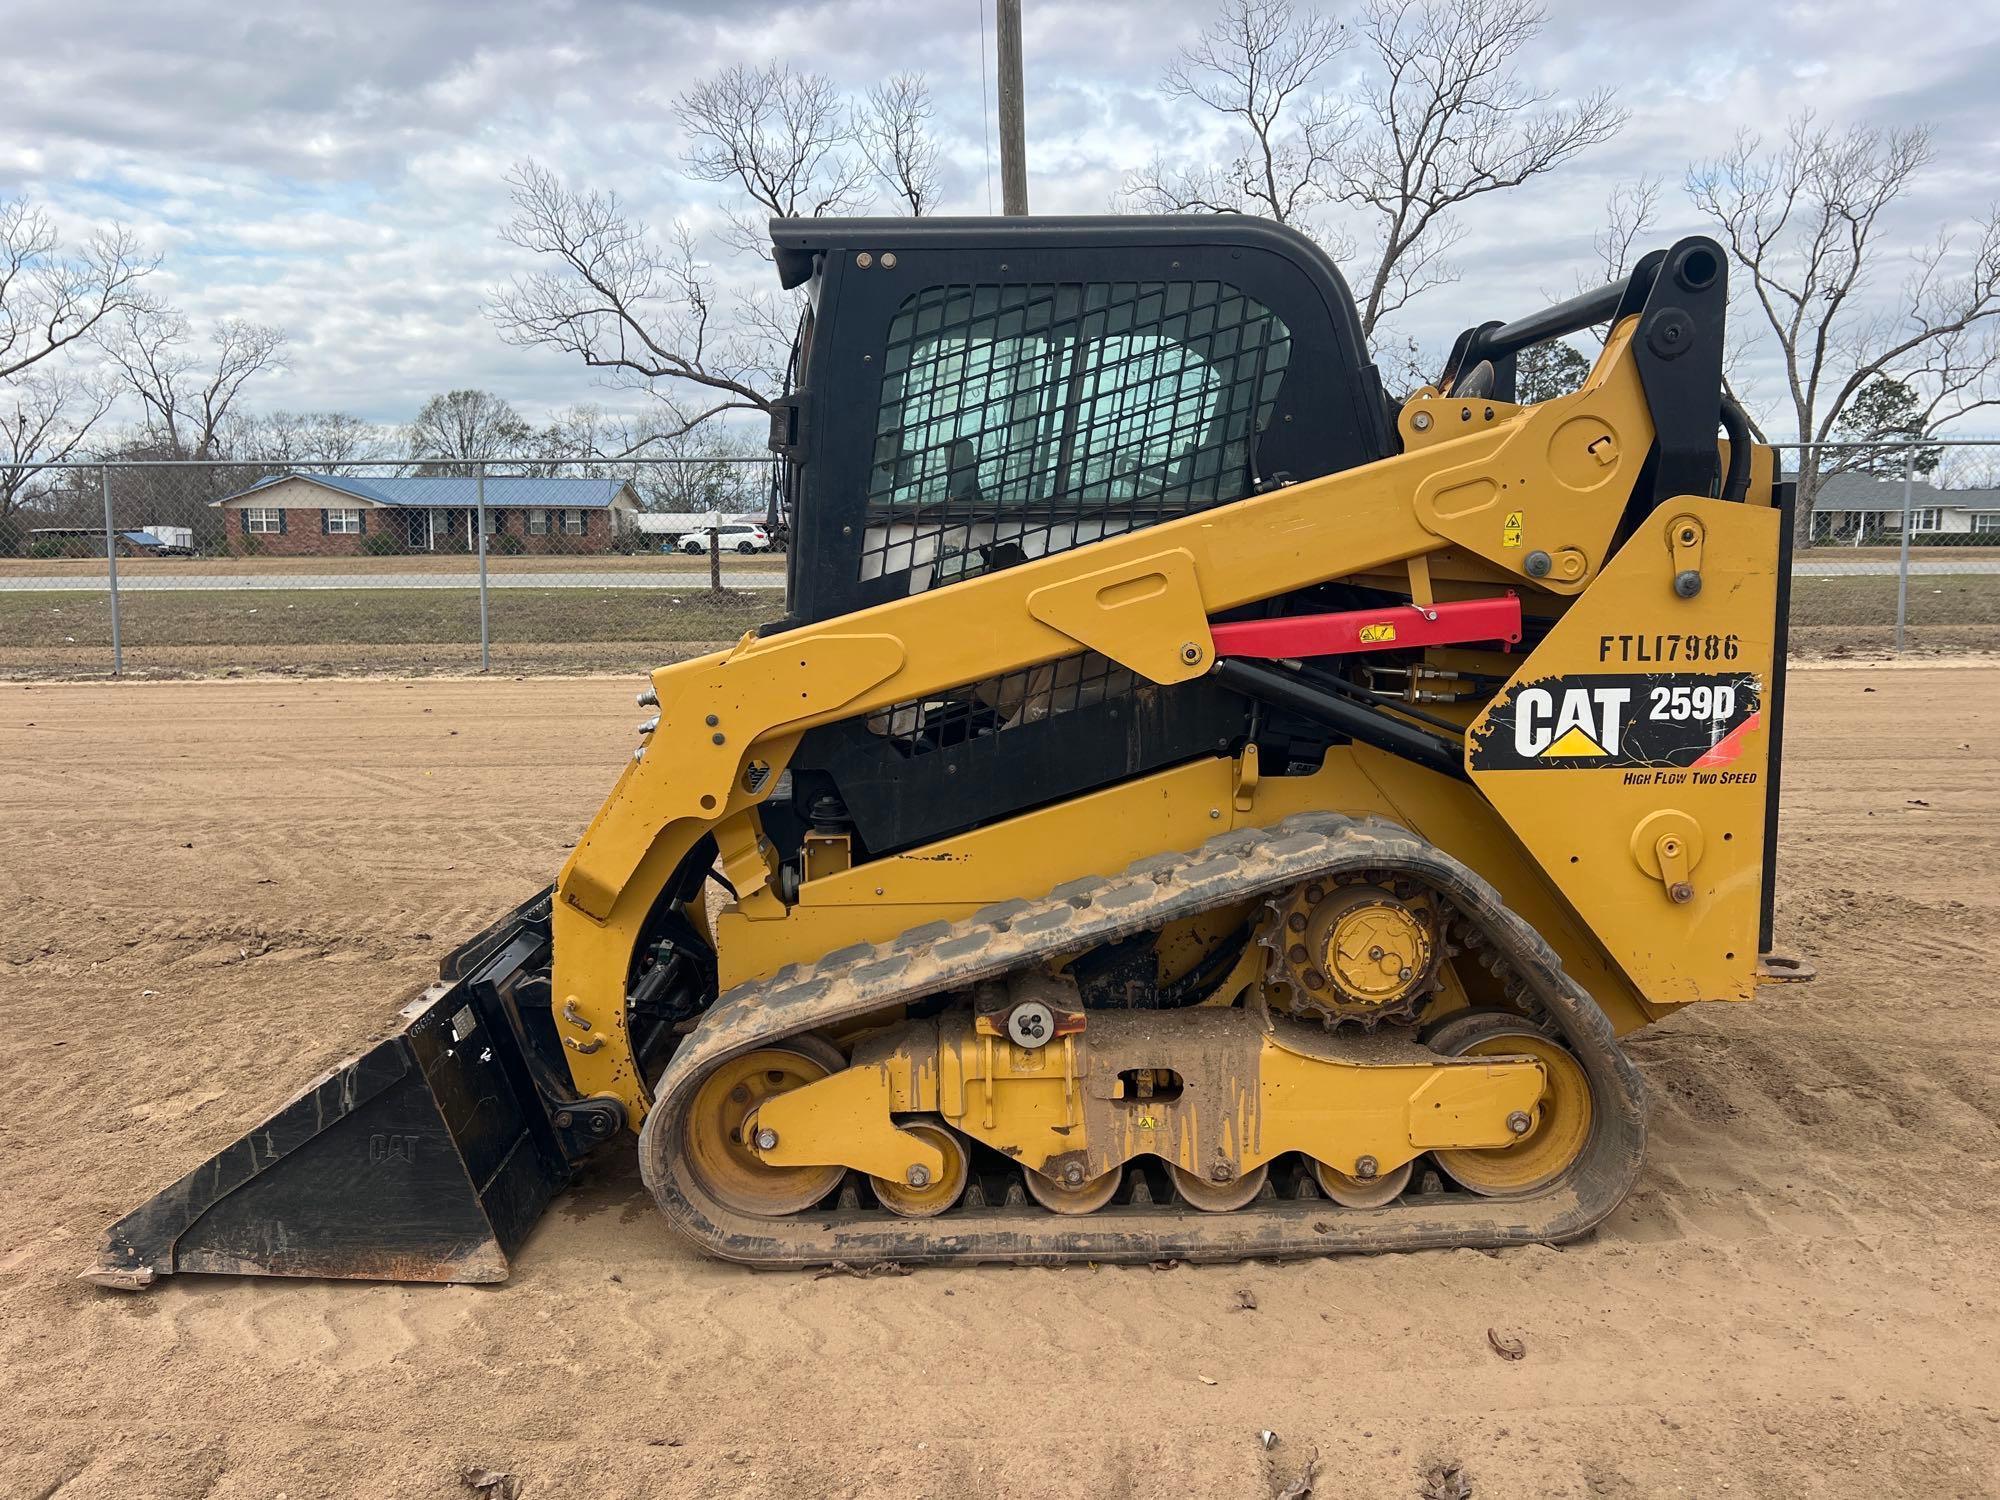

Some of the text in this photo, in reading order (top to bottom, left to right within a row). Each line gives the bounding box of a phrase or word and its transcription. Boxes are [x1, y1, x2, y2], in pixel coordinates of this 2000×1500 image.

[1650, 686, 1735, 720] 259D
[1515, 688, 1630, 757] CAT
[1623, 771, 1757, 785] HIGH FLOW TWO SPEED
[369, 1133, 420, 1164] CAT
